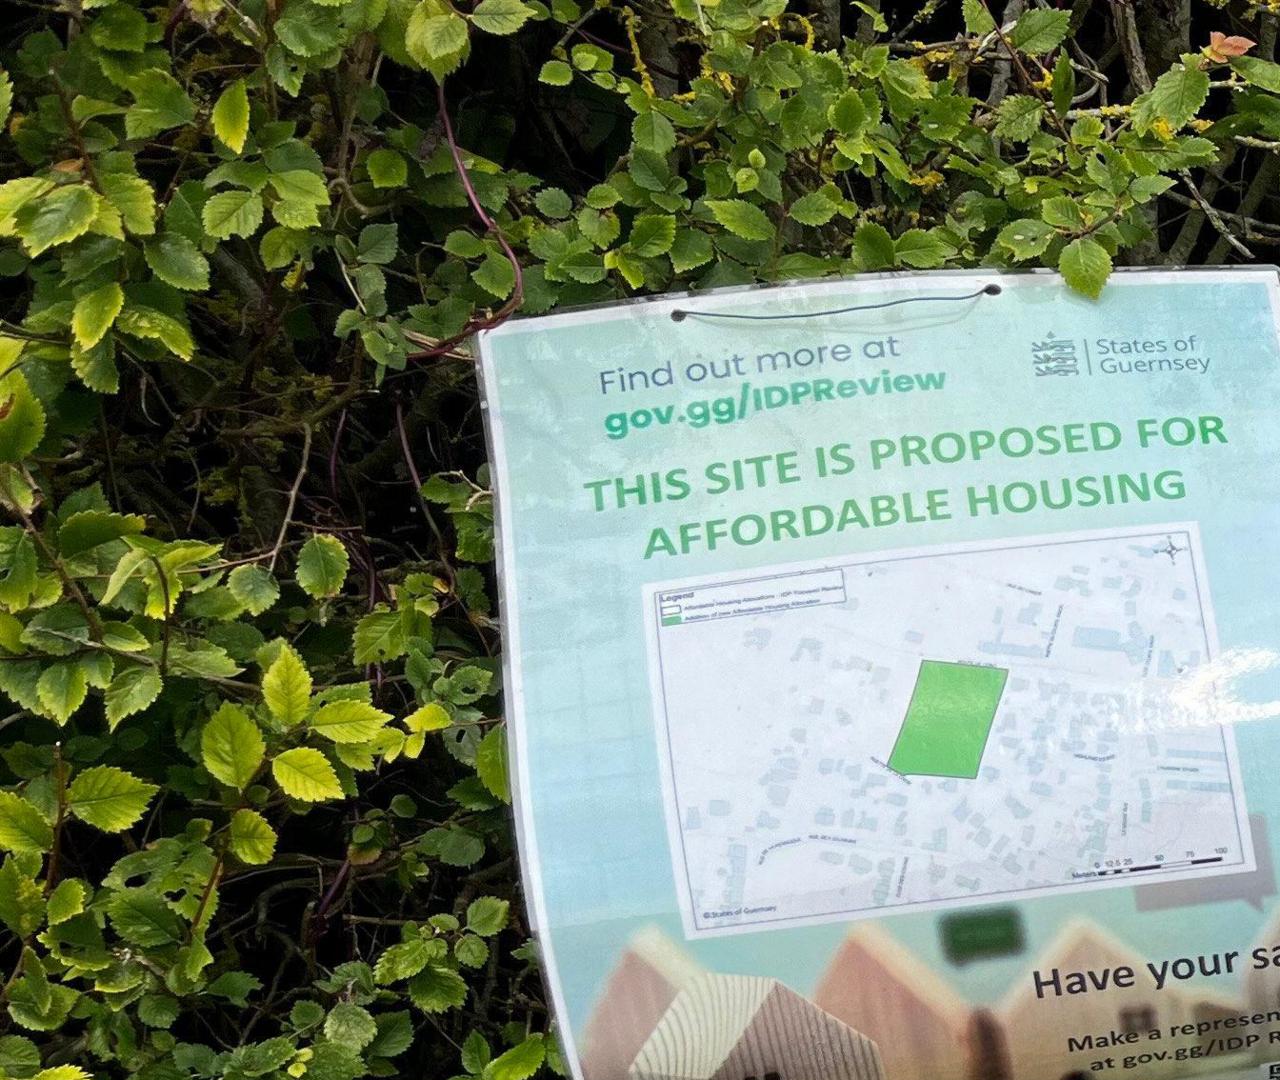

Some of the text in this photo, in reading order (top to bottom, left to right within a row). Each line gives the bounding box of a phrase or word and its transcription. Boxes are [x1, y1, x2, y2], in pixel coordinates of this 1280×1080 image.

[1096, 335, 1197, 355] States of
[599, 335, 901, 395] Find out more at
[1100, 356, 1210, 375] Guernsey
[604, 369, 946, 441] gov.gg/IDPReview
[583, 415, 1229, 512] THIS SITE IS PROPOSED FOR
[643, 470, 1186, 560] AFFORDABLE HOUSING
[660, 591, 695, 602] Legend
[1124, 858, 1133, 866] 25
[1155, 854, 1164, 862] 50
[1214, 847, 1228, 855] 100
[1033, 965, 1135, 999] Have
[1147, 950, 1239, 990] your
[1068, 1030, 1139, 1053] Make
[1148, 1028, 1162, 1041] a
[1090, 1057, 1115, 1072] at
[1123, 1033, 1260, 1069] gov.gg/IDP
